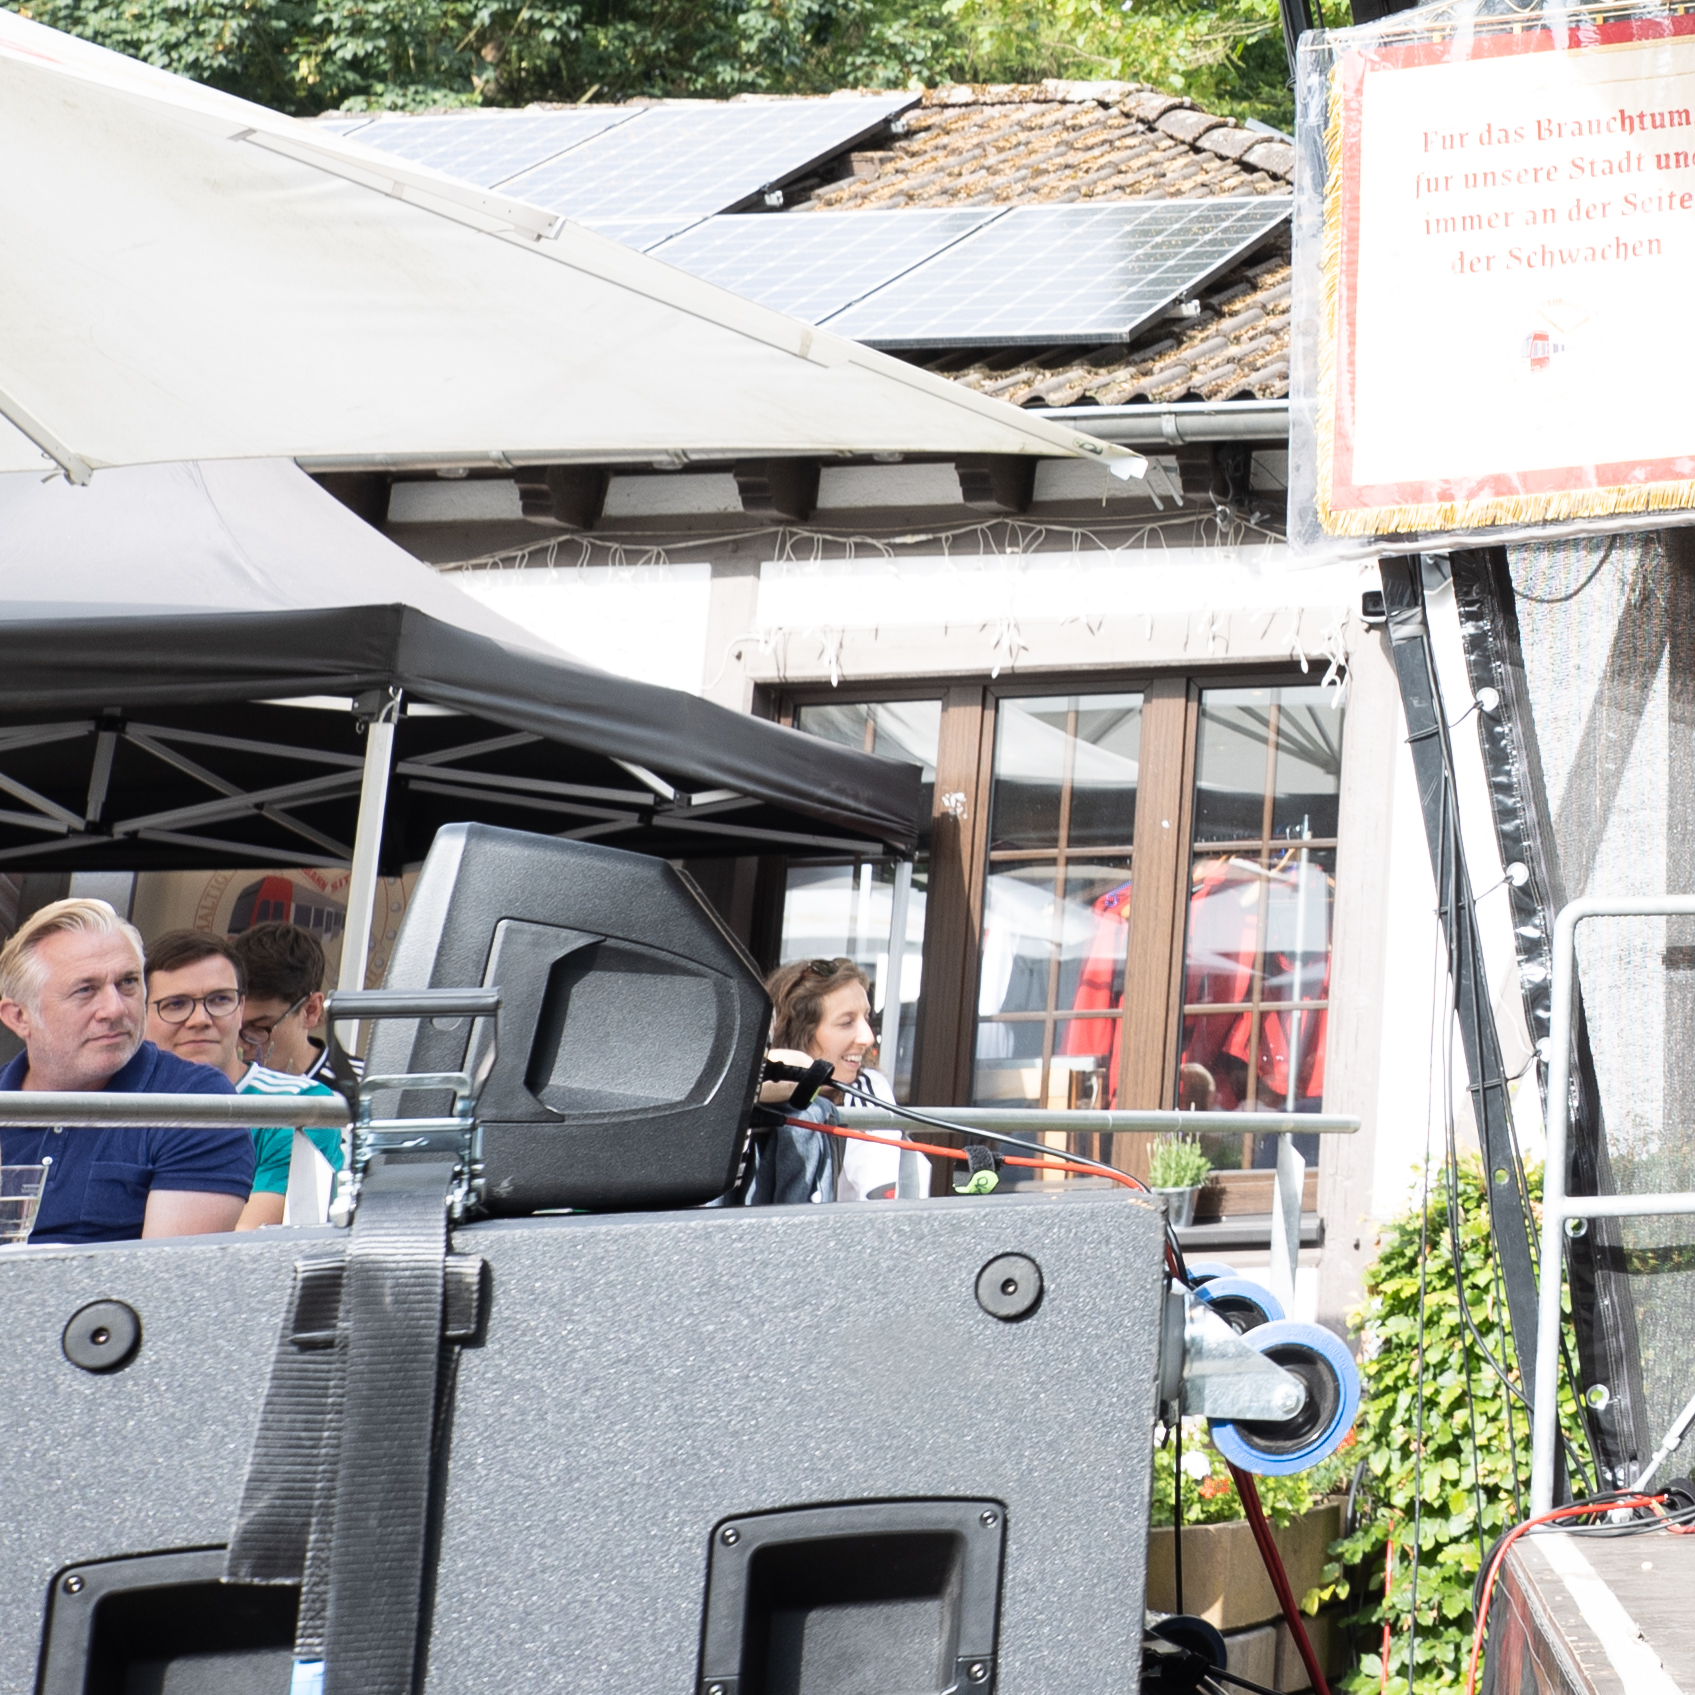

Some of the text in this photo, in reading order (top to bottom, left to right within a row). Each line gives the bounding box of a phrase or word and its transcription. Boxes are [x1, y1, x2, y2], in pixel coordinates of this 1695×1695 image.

[1478, 123, 1526, 147] das
[1464, 164, 1559, 190] unsere
[1568, 150, 1646, 180] Stadt
[1424, 188, 1694, 236] immer an der Seite
[1451, 235, 1664, 275] der Schwachen
